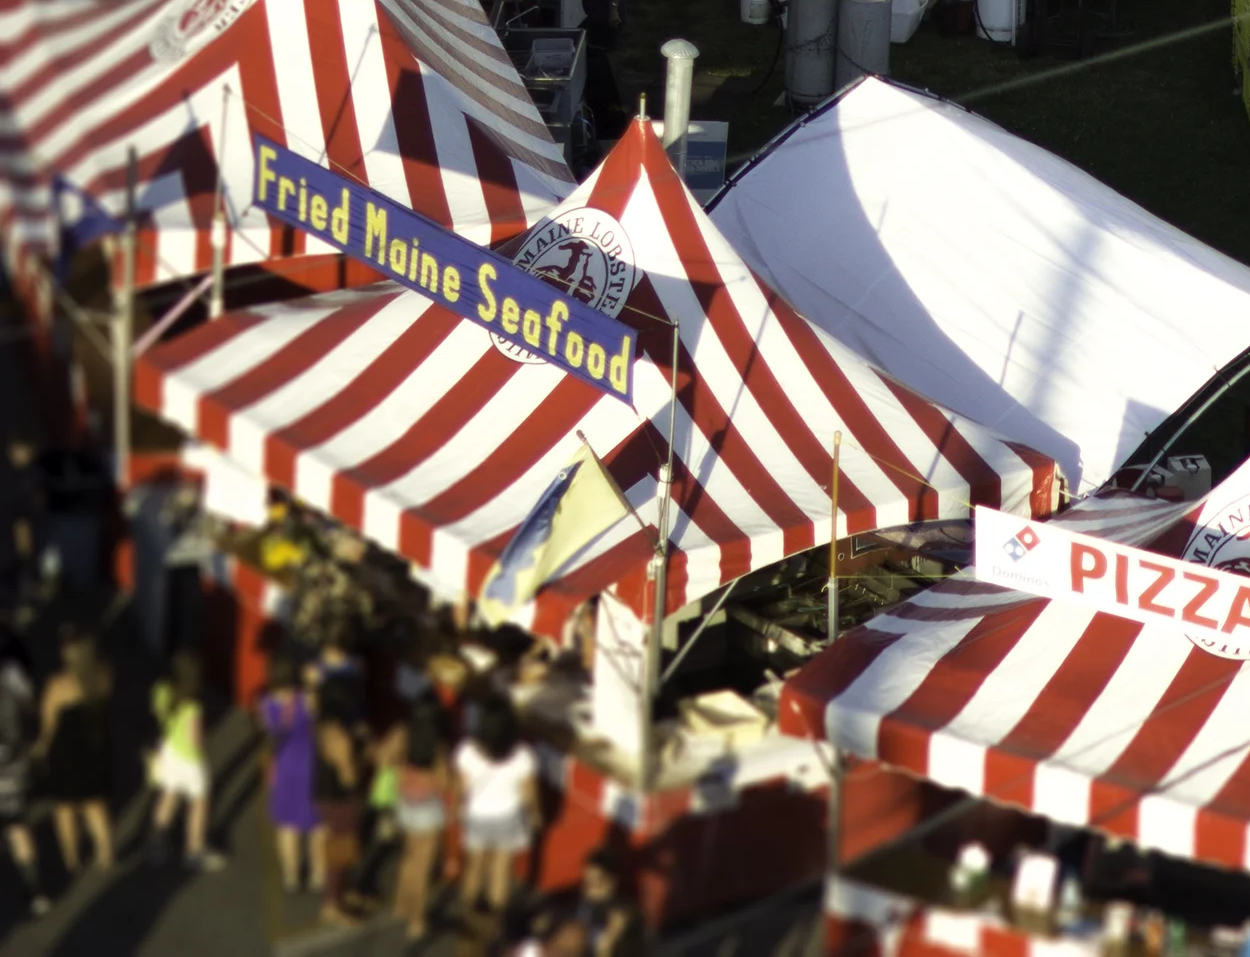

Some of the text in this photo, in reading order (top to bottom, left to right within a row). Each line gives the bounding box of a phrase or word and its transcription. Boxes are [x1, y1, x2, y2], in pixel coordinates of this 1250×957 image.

[258, 145, 631, 395] Fried Maine Seafood
[515, 217, 627, 318] MAINE LOBSTE
